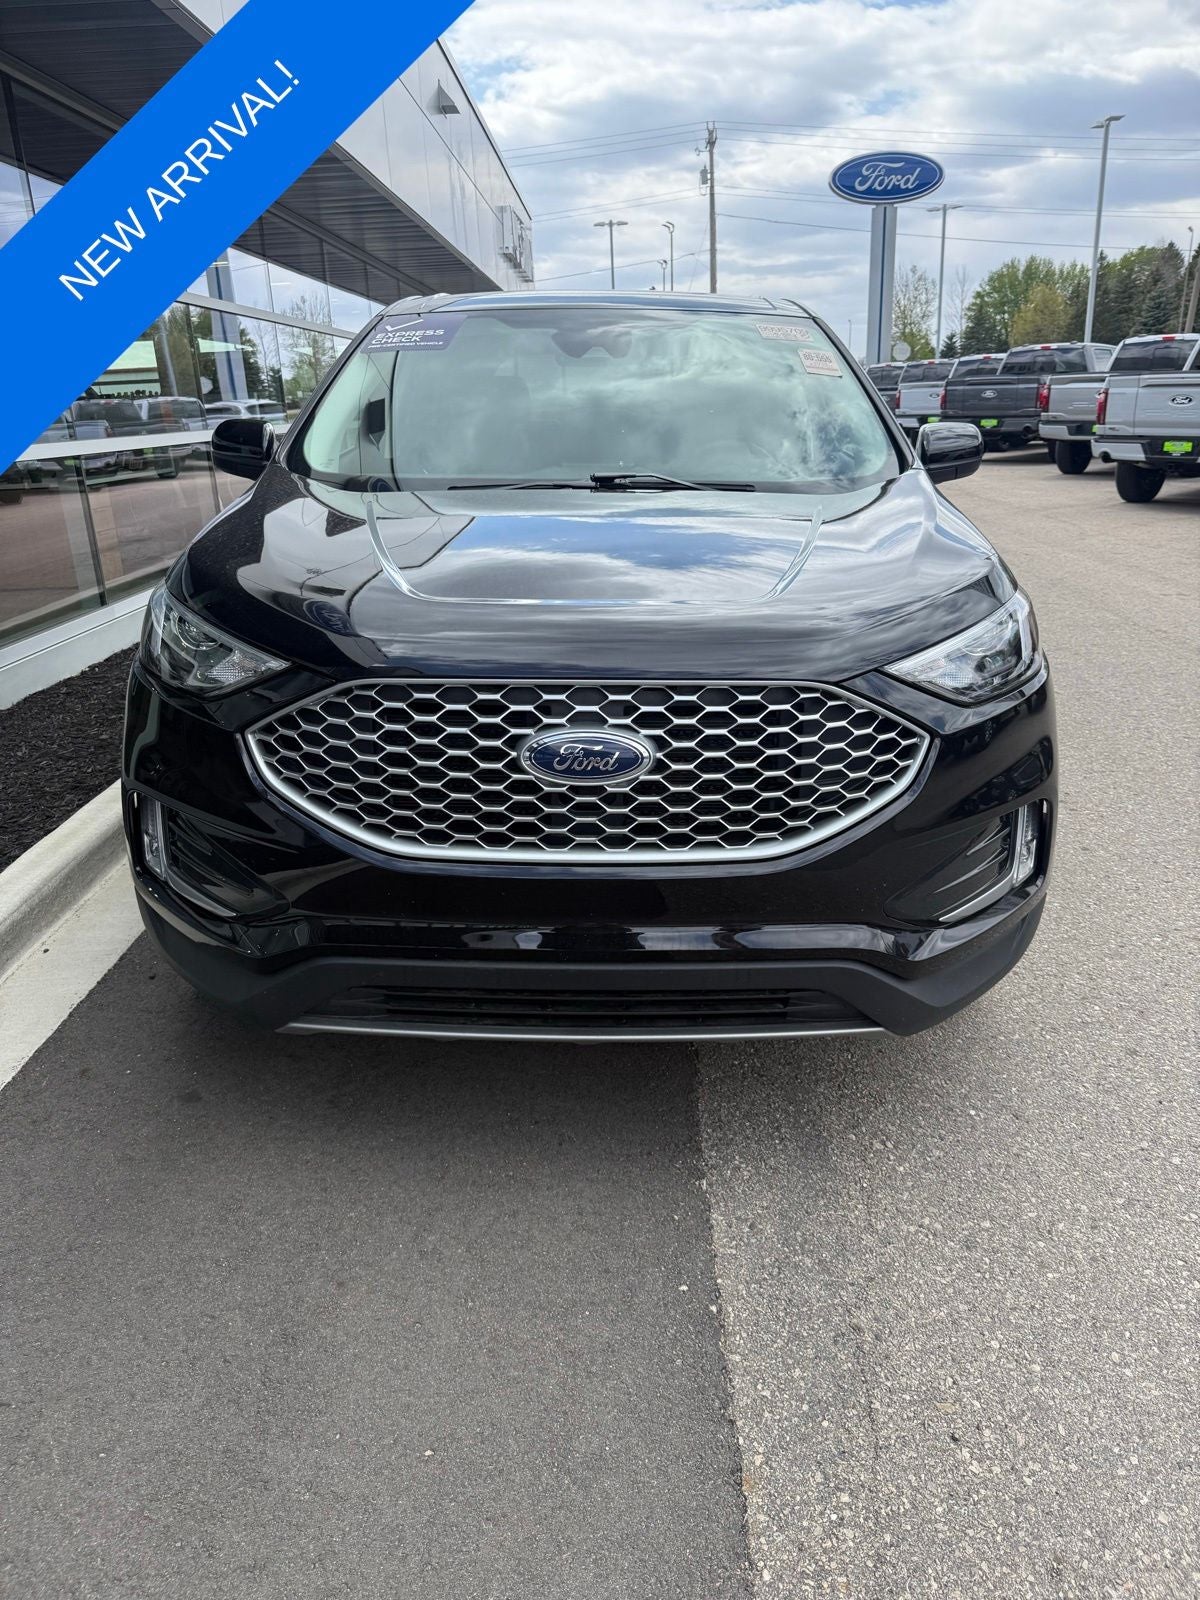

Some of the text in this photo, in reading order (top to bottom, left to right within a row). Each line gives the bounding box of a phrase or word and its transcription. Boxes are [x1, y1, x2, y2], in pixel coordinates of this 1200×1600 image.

[854, 161, 921, 192] Ford
[372, 336, 422, 344] CHECK
[376, 330, 445, 338] EXPRESS
[552, 743, 620, 771] Ford
